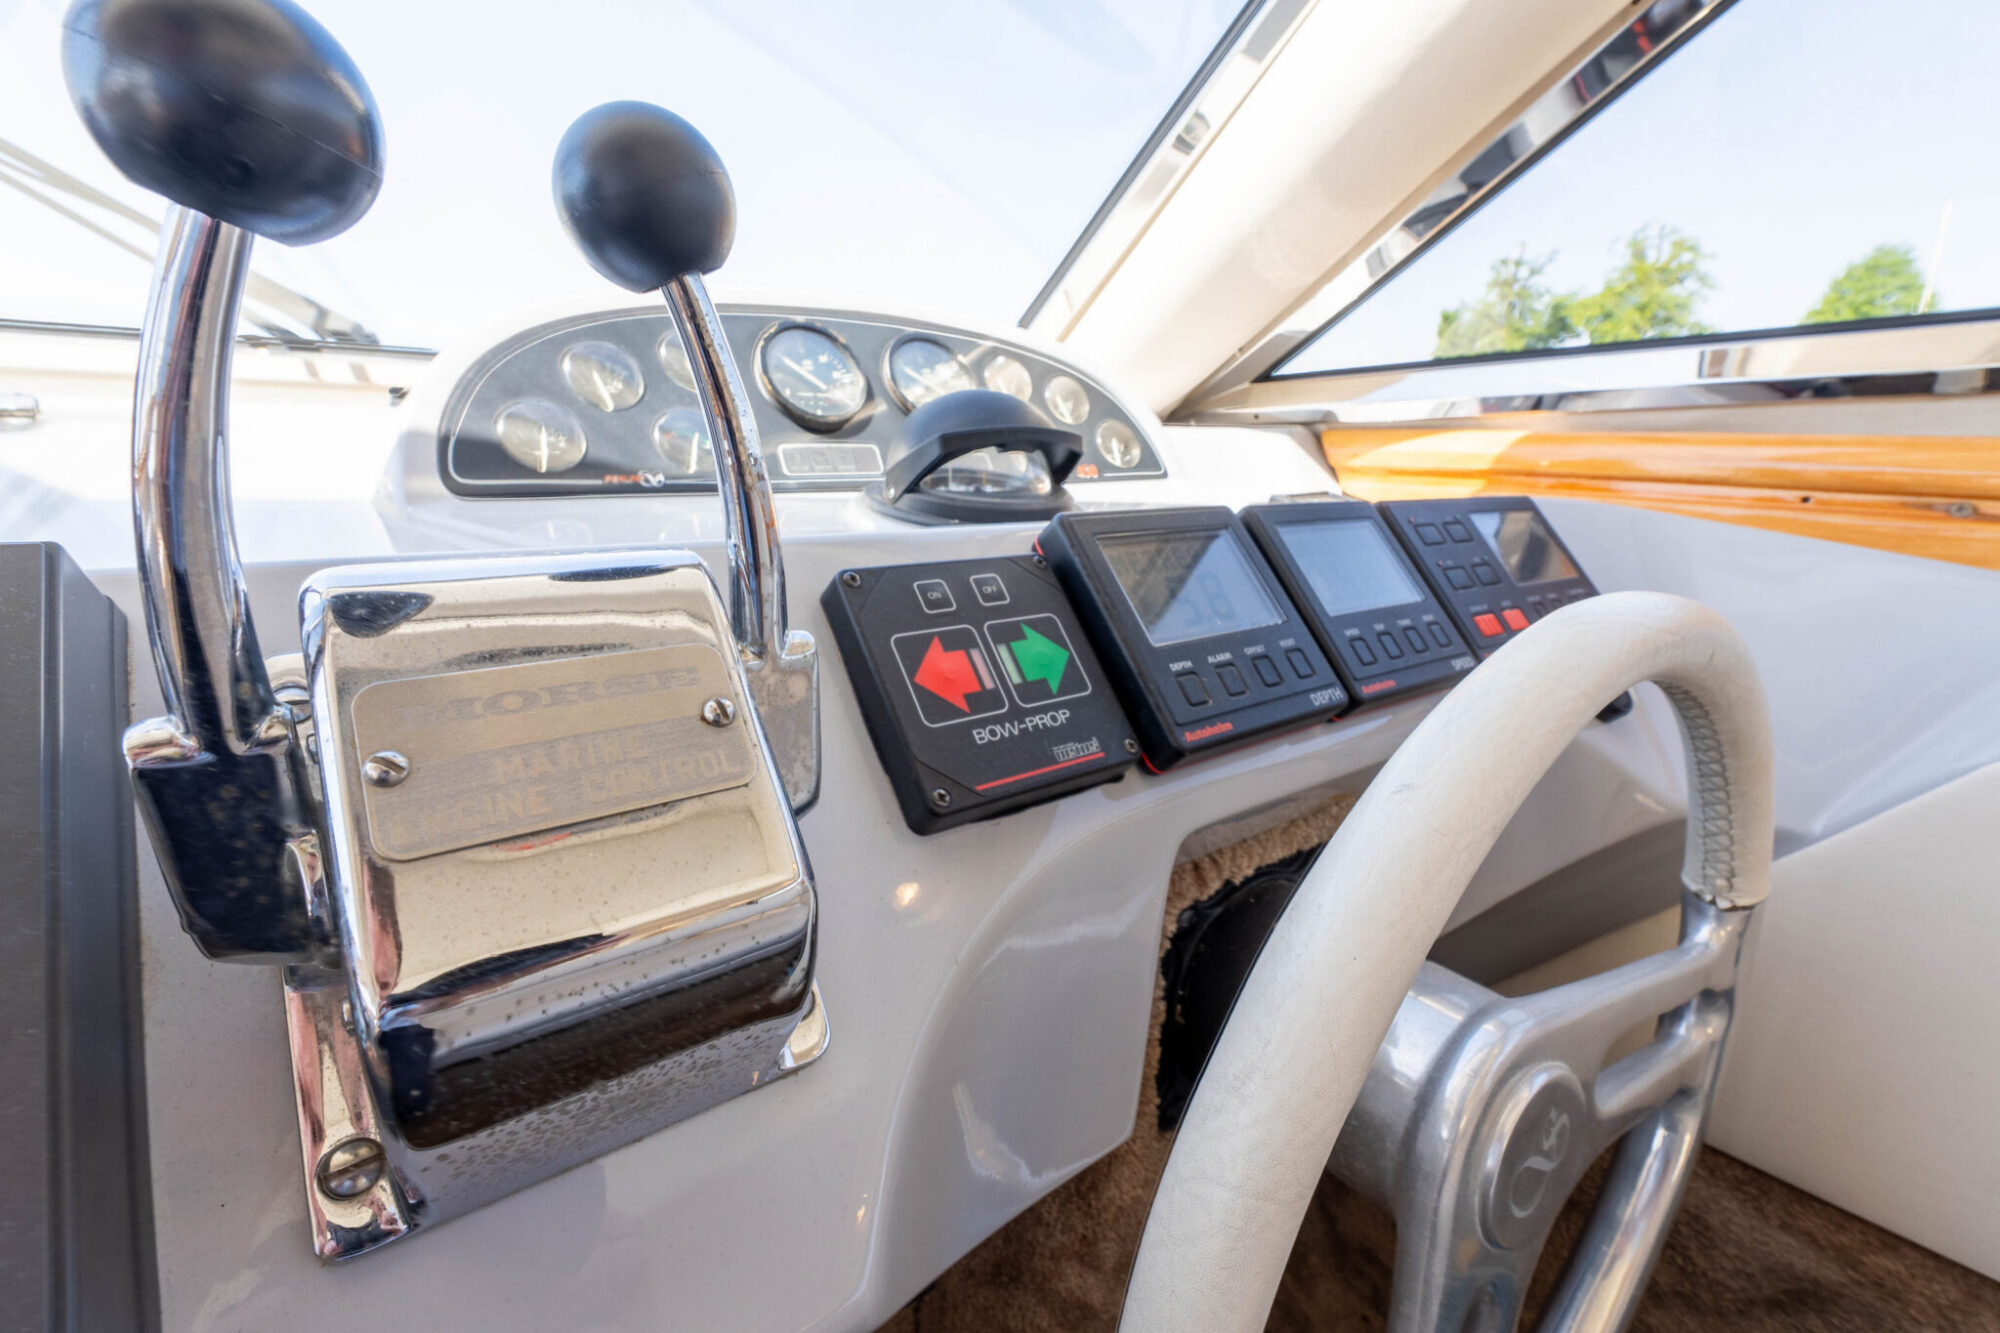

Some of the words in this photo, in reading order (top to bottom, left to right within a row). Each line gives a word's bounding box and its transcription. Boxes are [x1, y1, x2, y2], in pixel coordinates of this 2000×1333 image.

[927, 591, 942, 600] ON
[1169, 660, 1193, 671] DEPTH
[1207, 652, 1232, 663] ALARM
[1309, 687, 1344, 706] DEPTH
[972, 709, 1070, 744] BOW-PROP
[496, 730, 650, 785] MARINE
[582, 748, 742, 803] CONTROL
